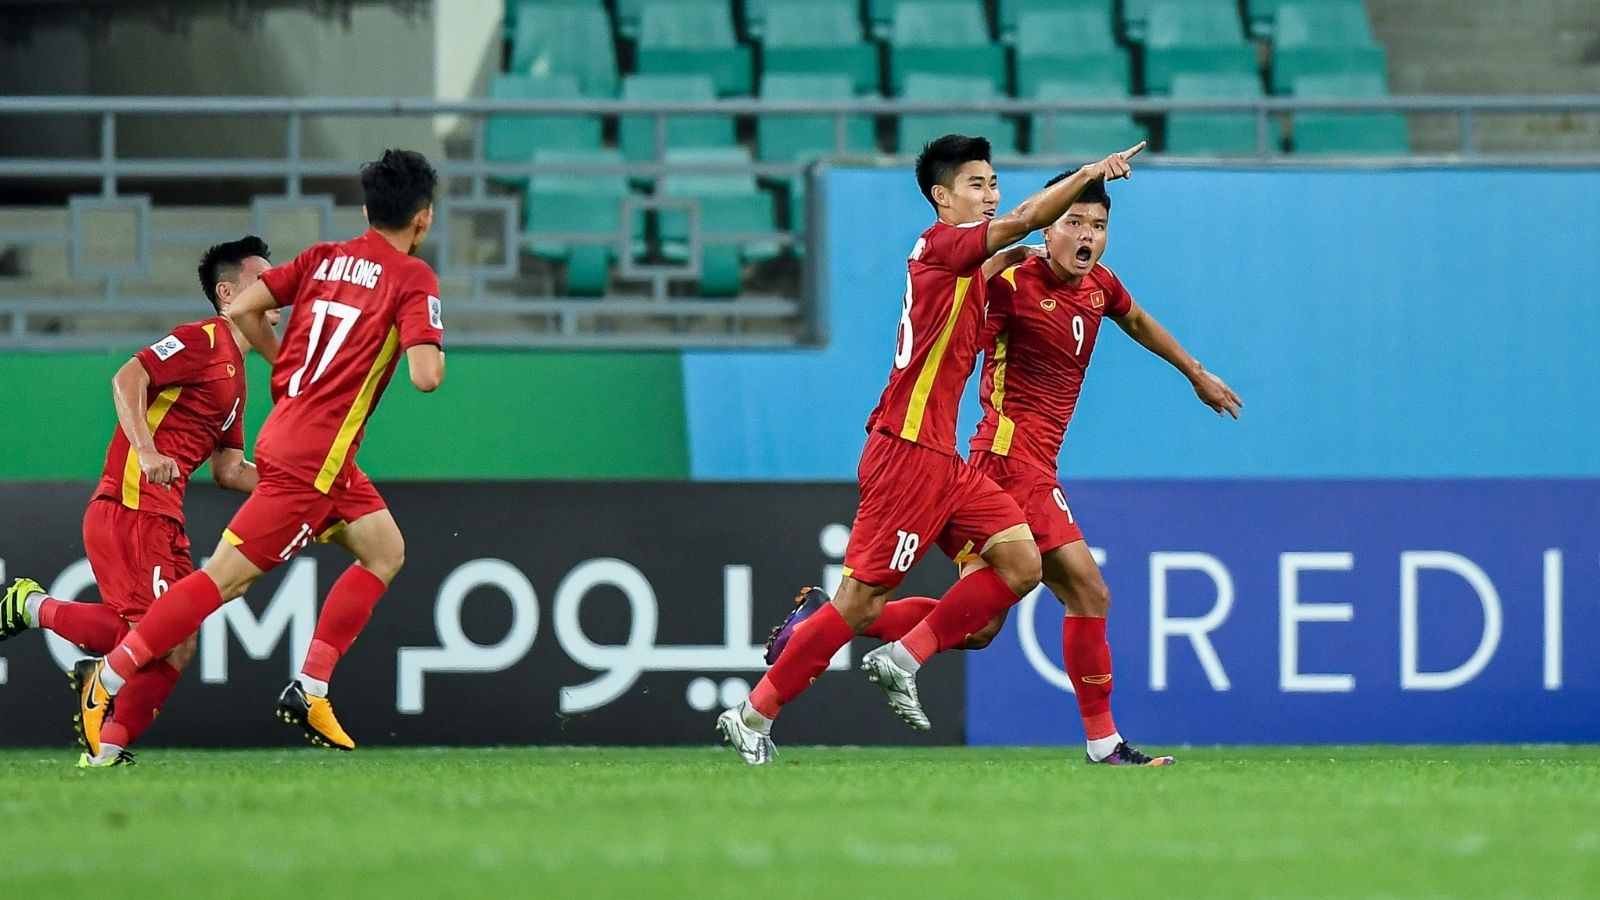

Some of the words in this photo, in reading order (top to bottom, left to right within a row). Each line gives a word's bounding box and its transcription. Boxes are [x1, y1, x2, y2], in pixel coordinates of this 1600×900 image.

[342, 256, 382, 290] LONG
[288, 300, 361, 397] 17
[1072, 315, 1084, 356] 9
[222, 397, 239, 431] 6
[1053, 488, 1073, 524] 9
[889, 529, 919, 572] 18
[153, 565, 169, 600] 6
[396, 525, 852, 714] نيوم
